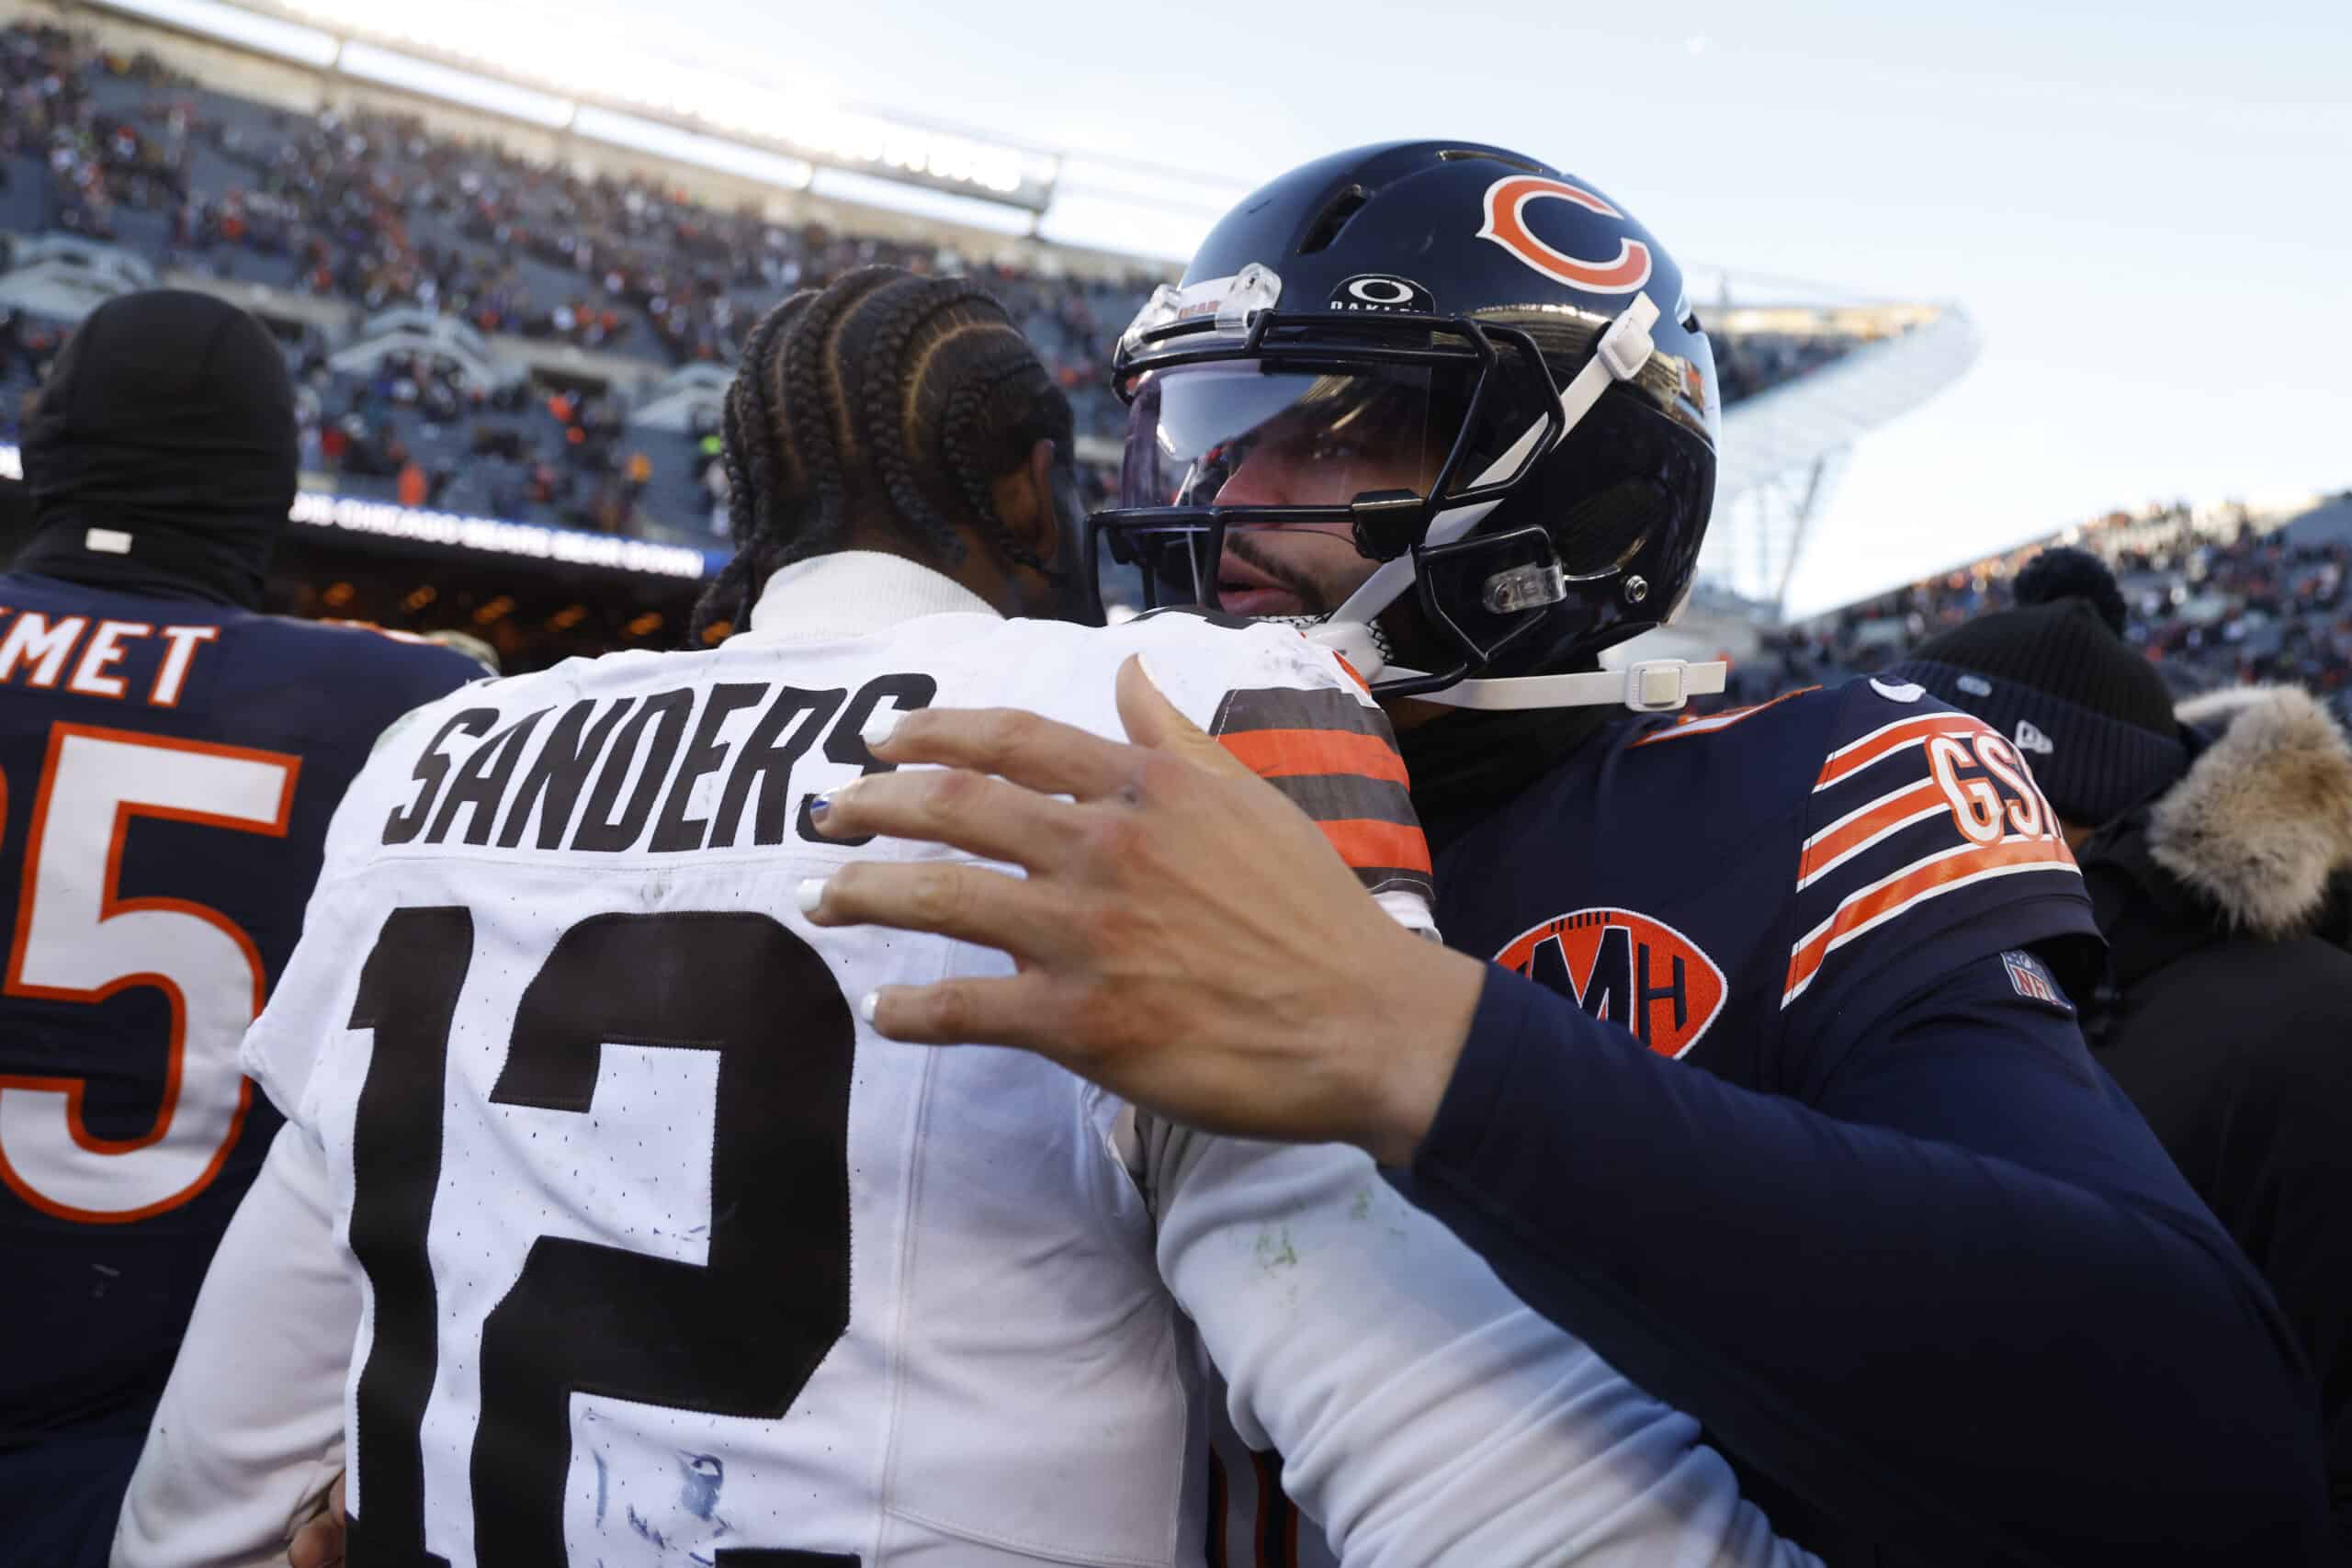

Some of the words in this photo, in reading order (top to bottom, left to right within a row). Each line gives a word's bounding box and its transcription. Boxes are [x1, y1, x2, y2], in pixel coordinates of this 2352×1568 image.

[0, 606, 221, 707] MET
[381, 673, 936, 853] SANDERS
[0, 720, 302, 1224] 5
[1516, 924, 1688, 1047] MH
[347, 905, 869, 1568] 12
